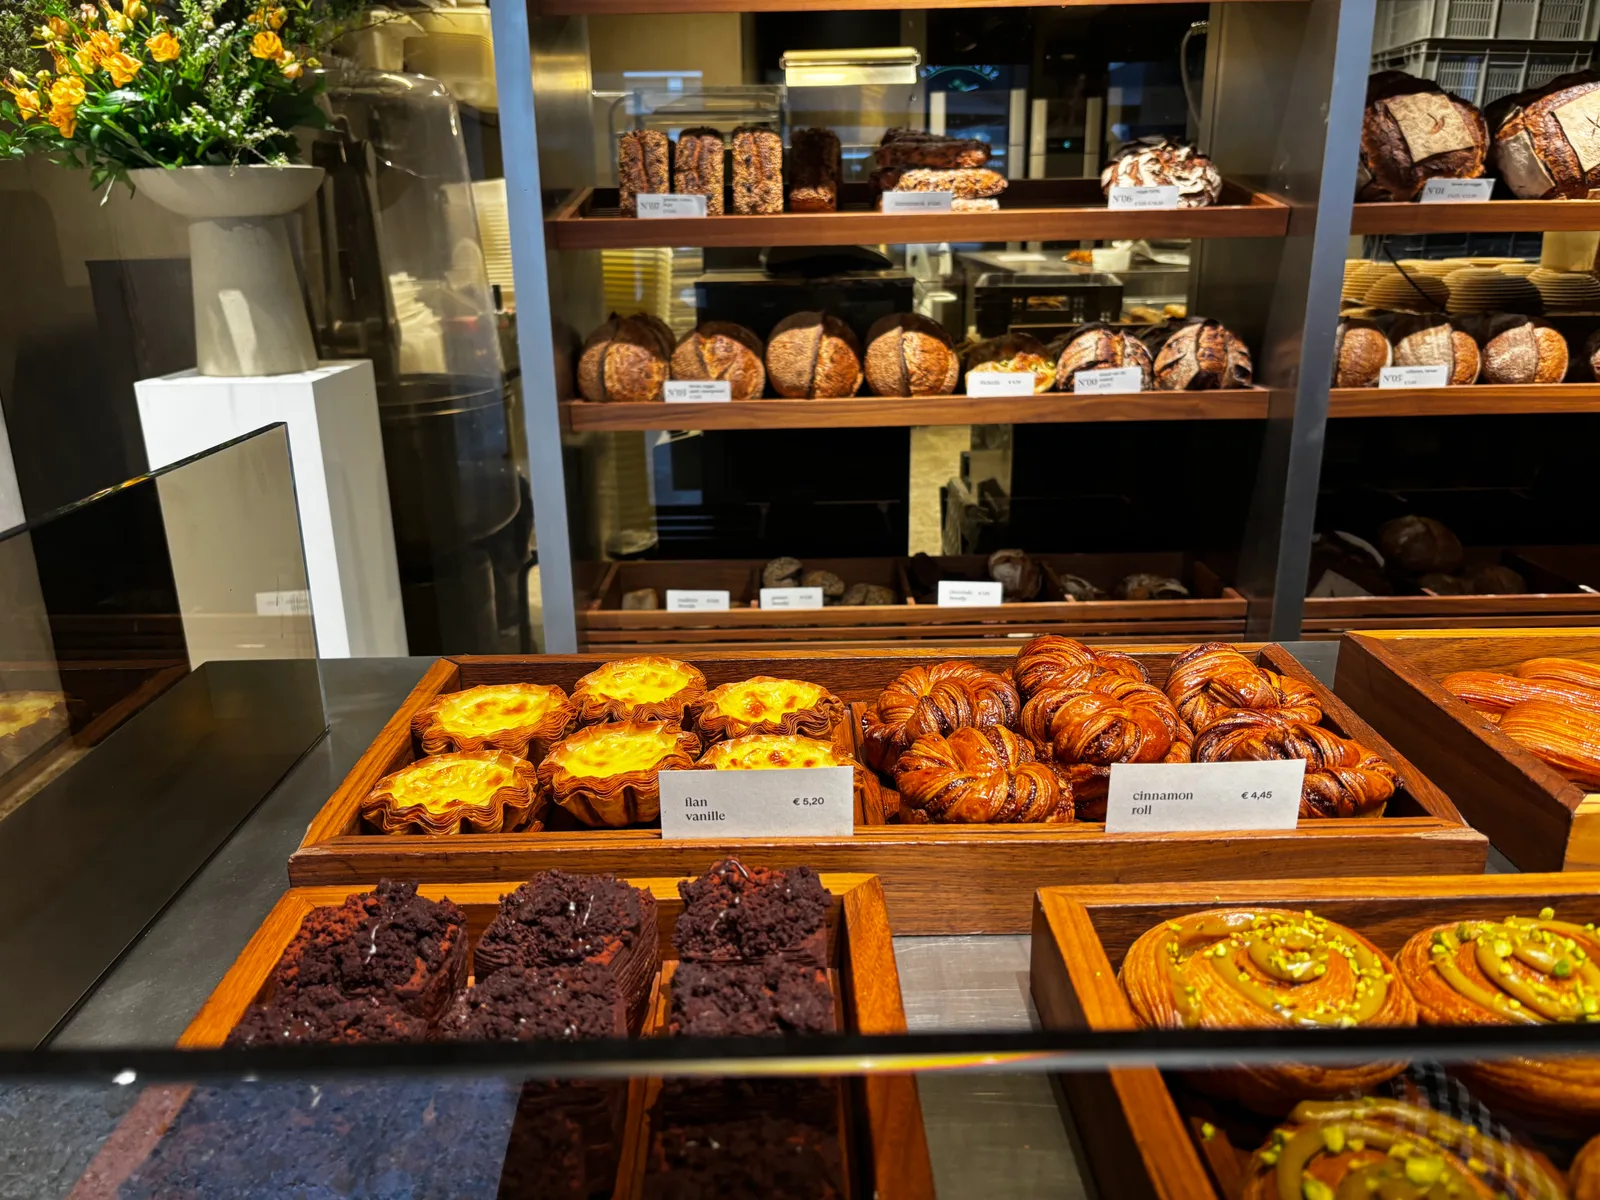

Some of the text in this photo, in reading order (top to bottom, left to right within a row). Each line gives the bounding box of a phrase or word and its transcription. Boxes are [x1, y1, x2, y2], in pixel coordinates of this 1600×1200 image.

[685, 796, 825, 807] flan € 5,20
[1132, 791, 1273, 801] cinnamon € 4,45
[1131, 804, 1152, 815] roll
[685, 810, 726, 821] vanille
